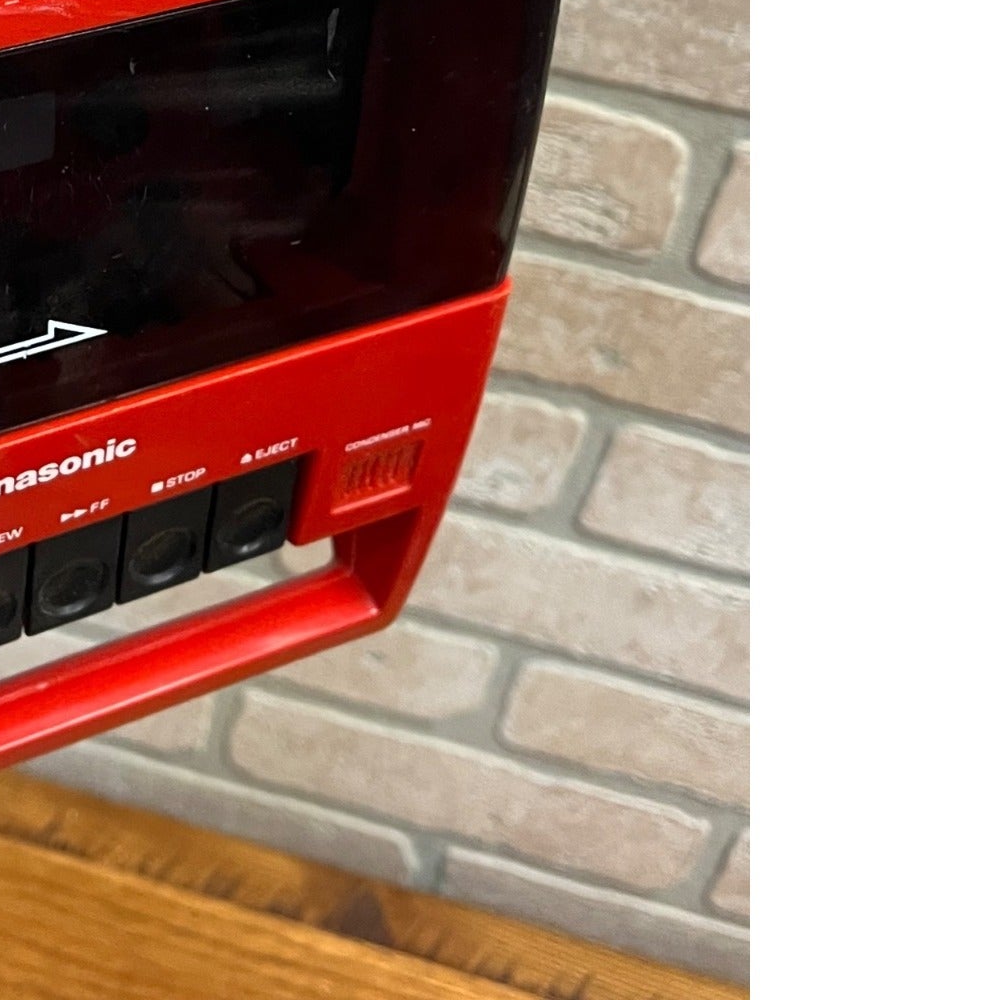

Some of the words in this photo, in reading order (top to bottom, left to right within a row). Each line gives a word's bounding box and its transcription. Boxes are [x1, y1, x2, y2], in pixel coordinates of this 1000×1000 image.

[255, 437, 298, 460] EJECT
[166, 467, 206, 489] STOP
[90, 498, 110, 514] FF
